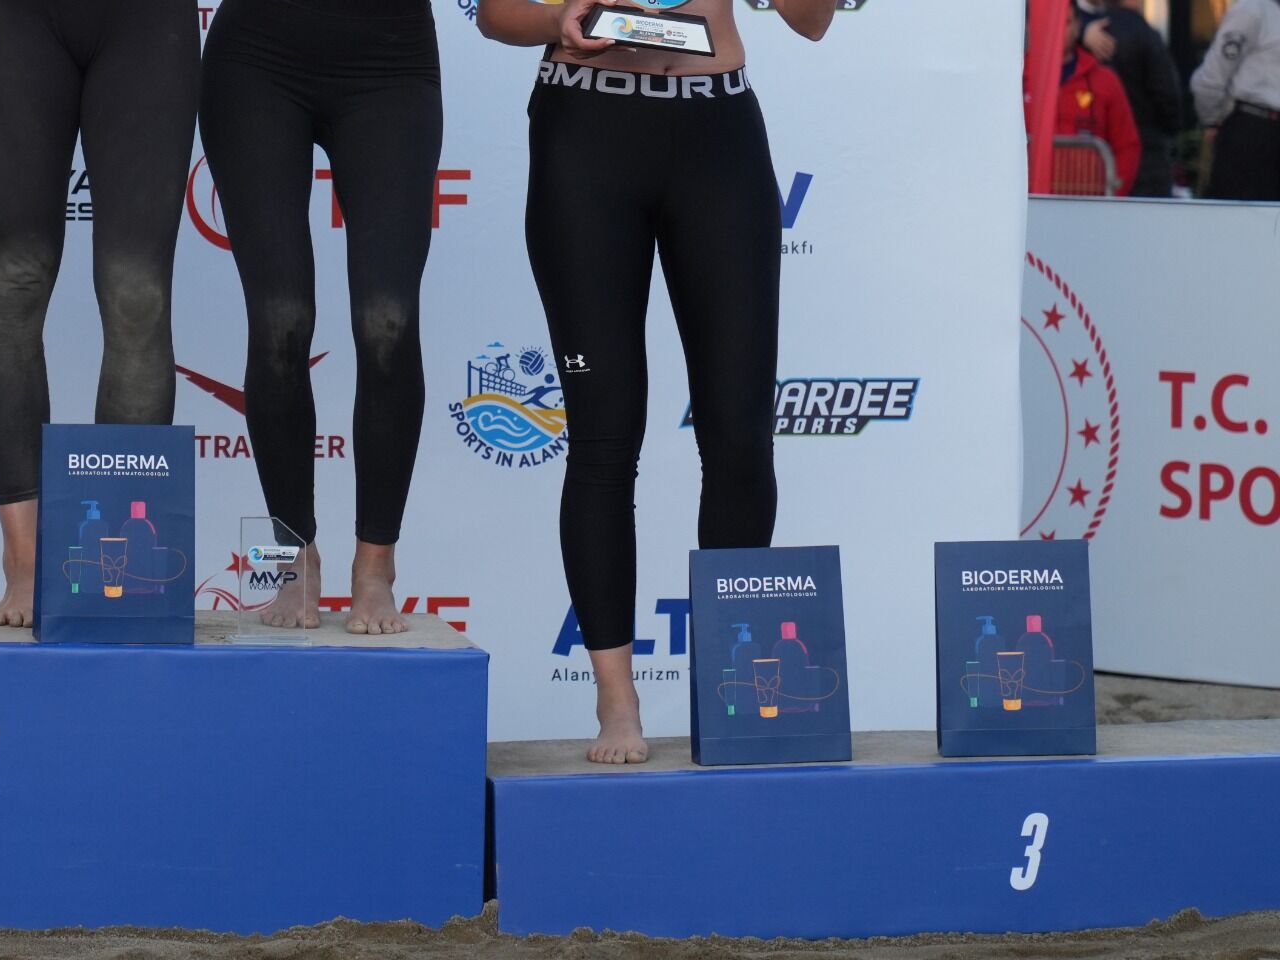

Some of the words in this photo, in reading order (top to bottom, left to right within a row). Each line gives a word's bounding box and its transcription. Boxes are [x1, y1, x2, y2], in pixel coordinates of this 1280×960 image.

[536, 61, 716, 99] RMOUR
[780, 241, 814, 254] akfı
[1159, 369, 1268, 435] T.C.
[449, 401, 494, 460] SPORTS
[495, 451, 514, 468] IN
[518, 431, 570, 468] ALANY
[775, 417, 858, 435] PORTS
[68, 454, 169, 470] BIODERMA
[1159, 460, 1280, 526] SPO
[249, 571, 298, 585] MVP
[717, 576, 817, 593] BIODERMA
[962, 569, 1064, 585] BIODERMA
[249, 583, 284, 591] WOMAN
[632, 667, 680, 681] urizm
[1010, 812, 1049, 891] 3
